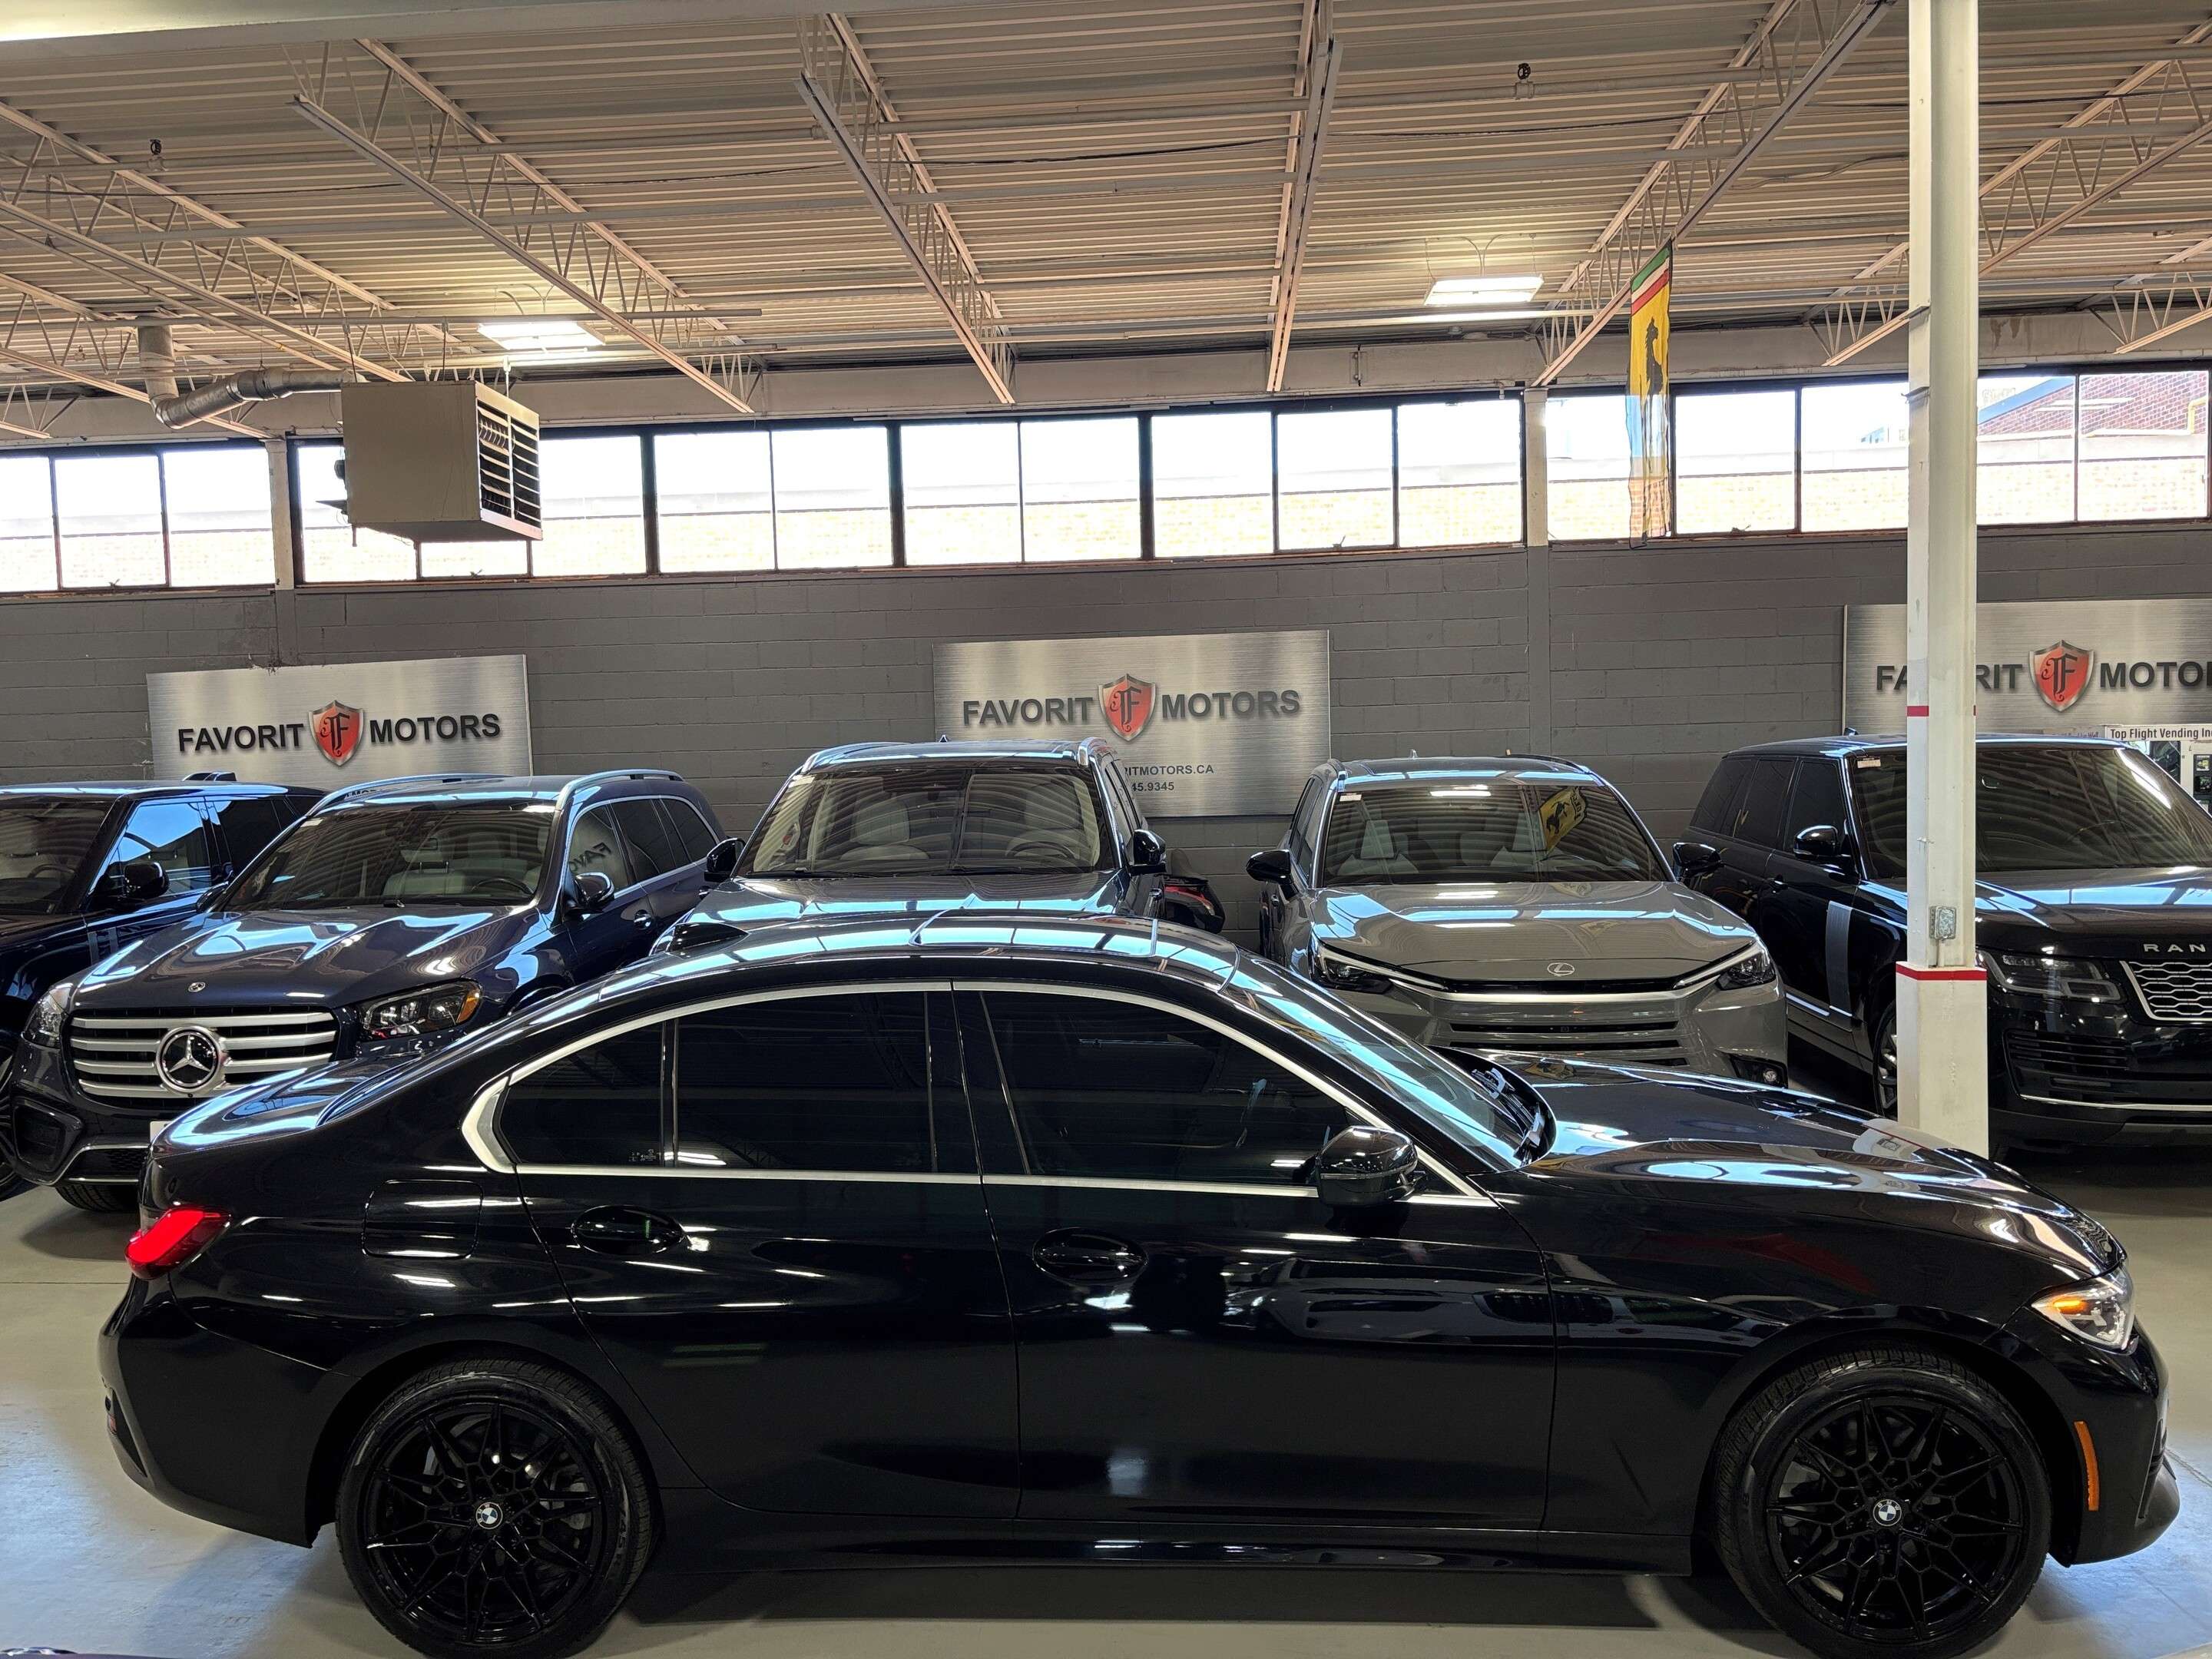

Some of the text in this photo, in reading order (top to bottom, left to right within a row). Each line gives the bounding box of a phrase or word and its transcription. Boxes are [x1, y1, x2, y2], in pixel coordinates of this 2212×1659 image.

[1876, 664, 2023, 690] FARIT
[2100, 661, 2212, 687] MOTO
[963, 697, 1094, 726] FAVORIT
[1161, 689, 1300, 720] MOTORS
[178, 724, 304, 752] FAVORIT
[369, 713, 501, 743] MOTORS
[2111, 727, 2212, 740] Top Flight Vending In
